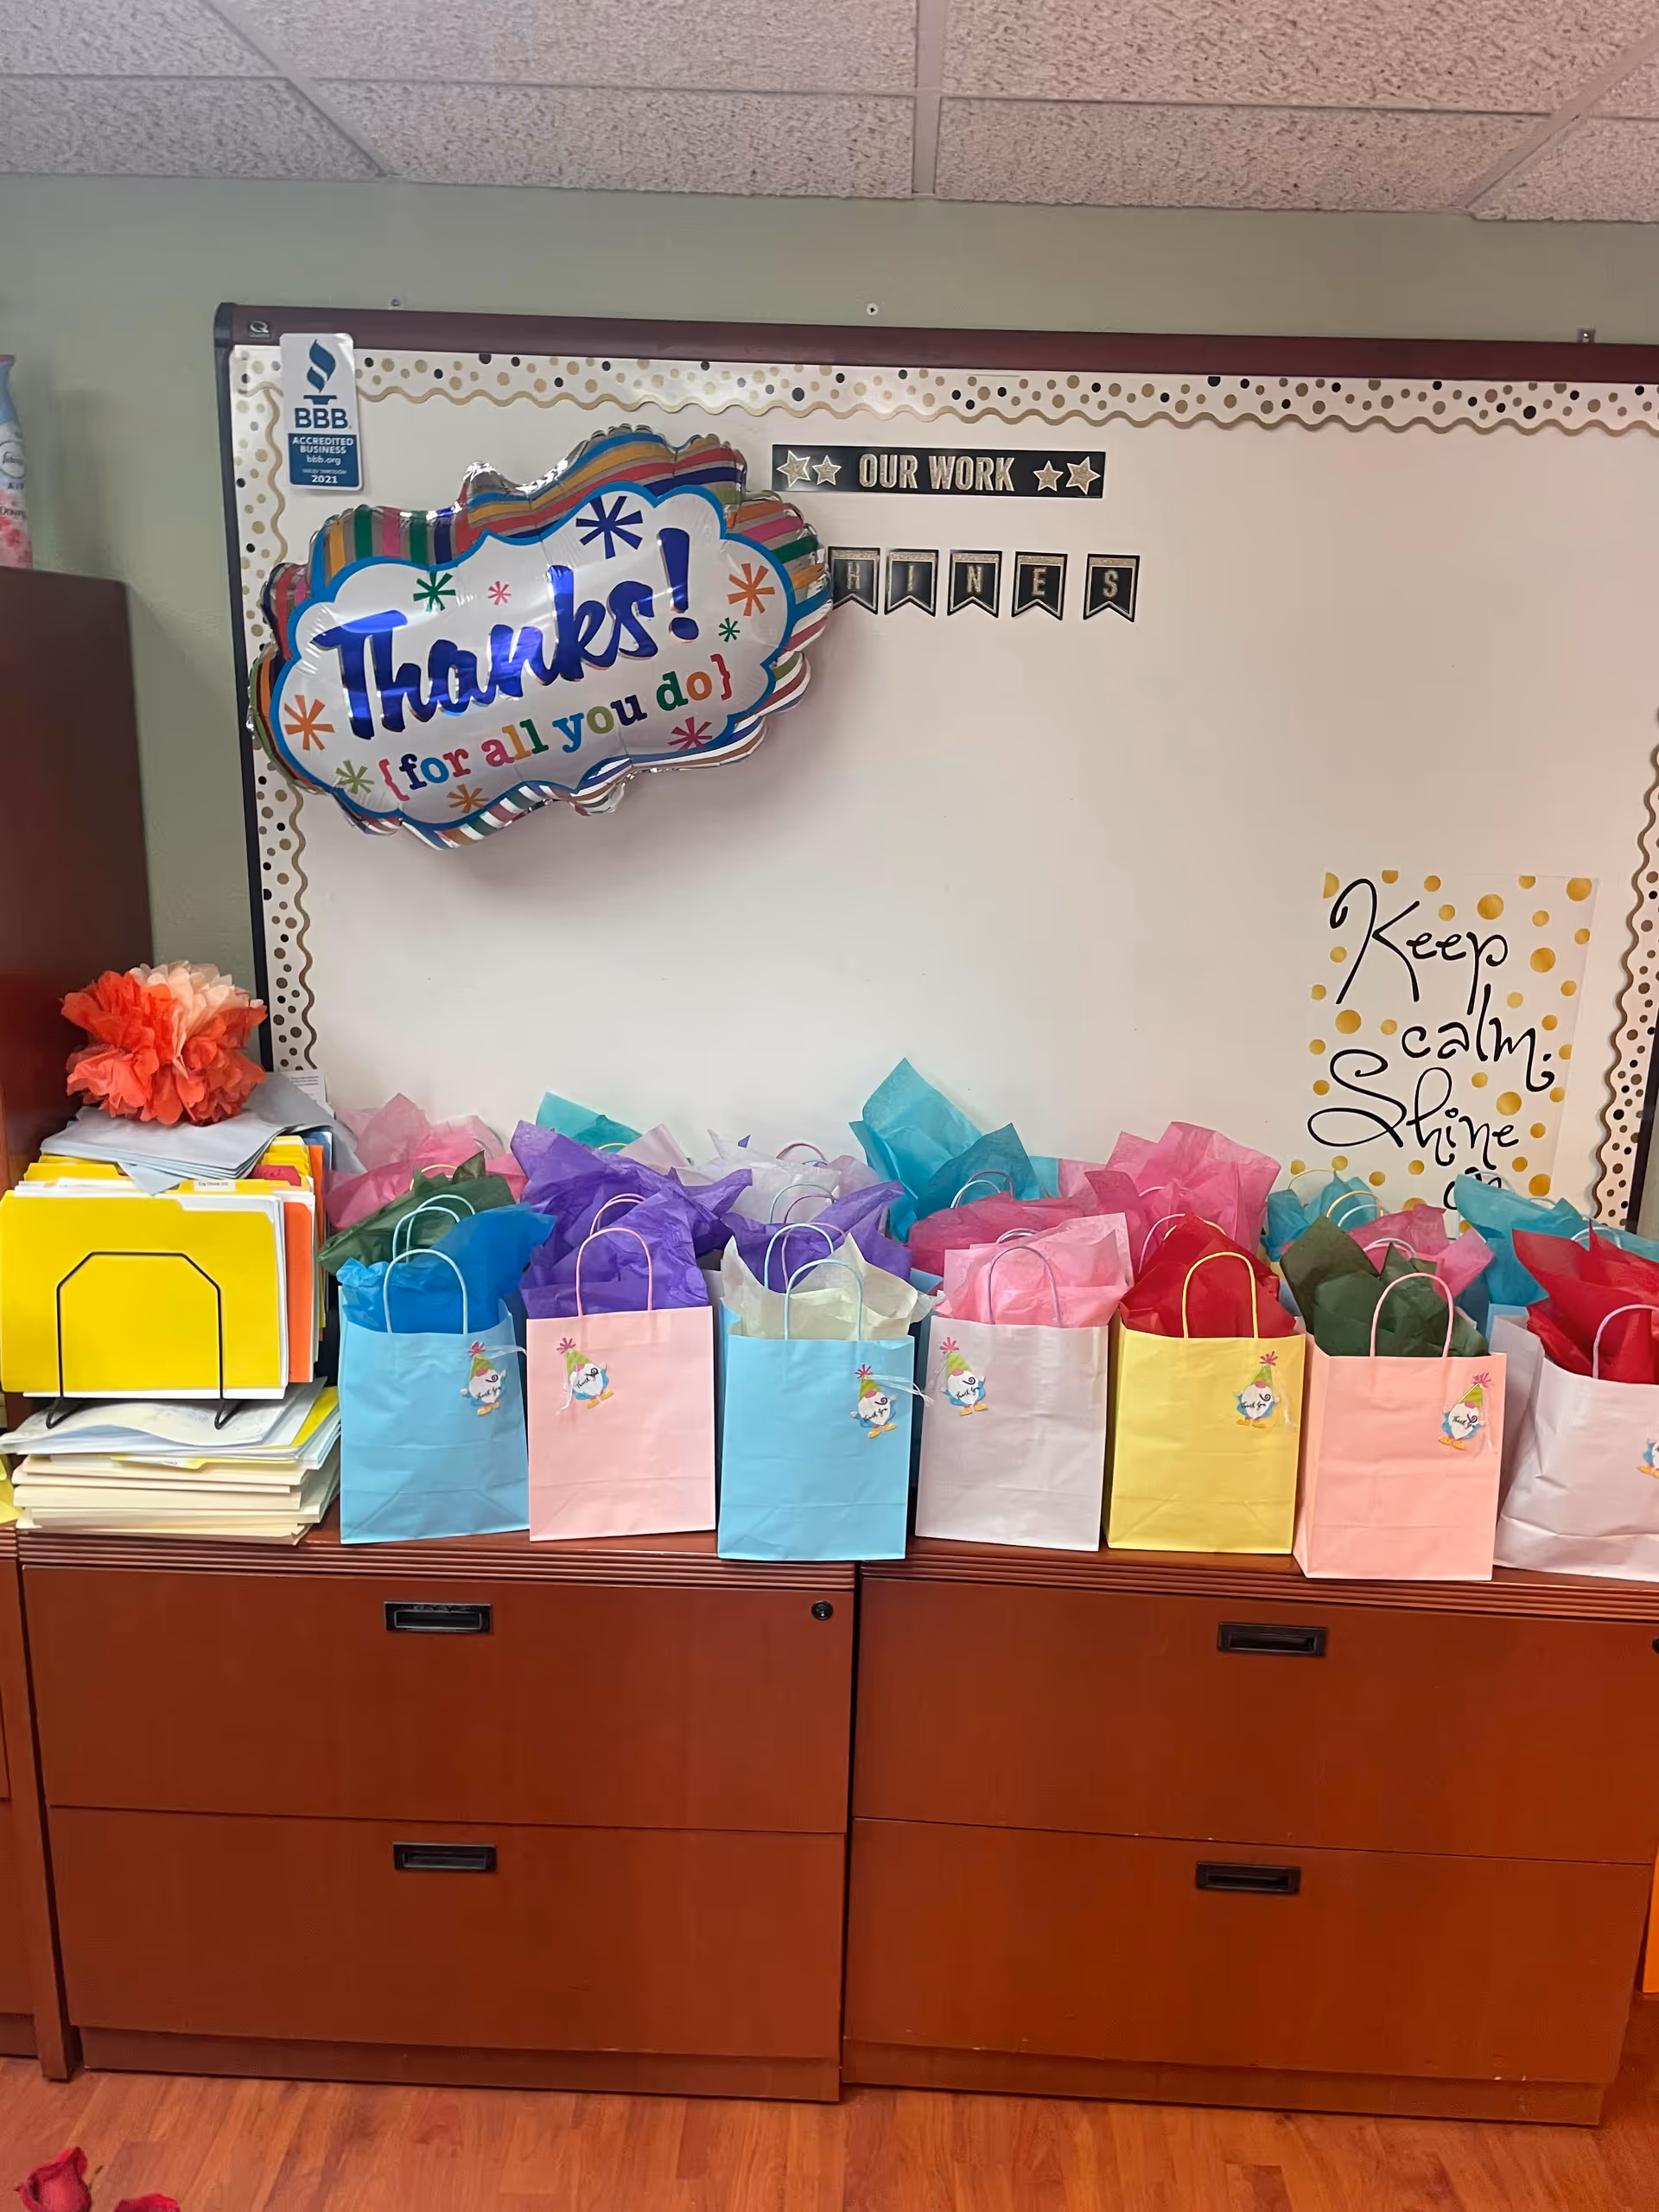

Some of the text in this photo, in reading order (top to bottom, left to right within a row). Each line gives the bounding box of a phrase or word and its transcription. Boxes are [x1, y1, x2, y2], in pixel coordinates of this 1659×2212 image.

[294, 407, 349, 429] BBB
[292, 435, 354, 446] ACCREDITED
[299, 444, 347, 454] BUSINESS
[306, 454, 341, 466] bbb.org
[858, 452, 1015, 492] OUR WORK
[311, 474, 339, 484] 2021
[309, 527, 700, 741] Thanks!
[480, 719, 549, 767] all
[552, 694, 647, 753] you
[1328, 878, 1509, 1015] Keep
[1307, 1048, 1519, 1170] Shine
